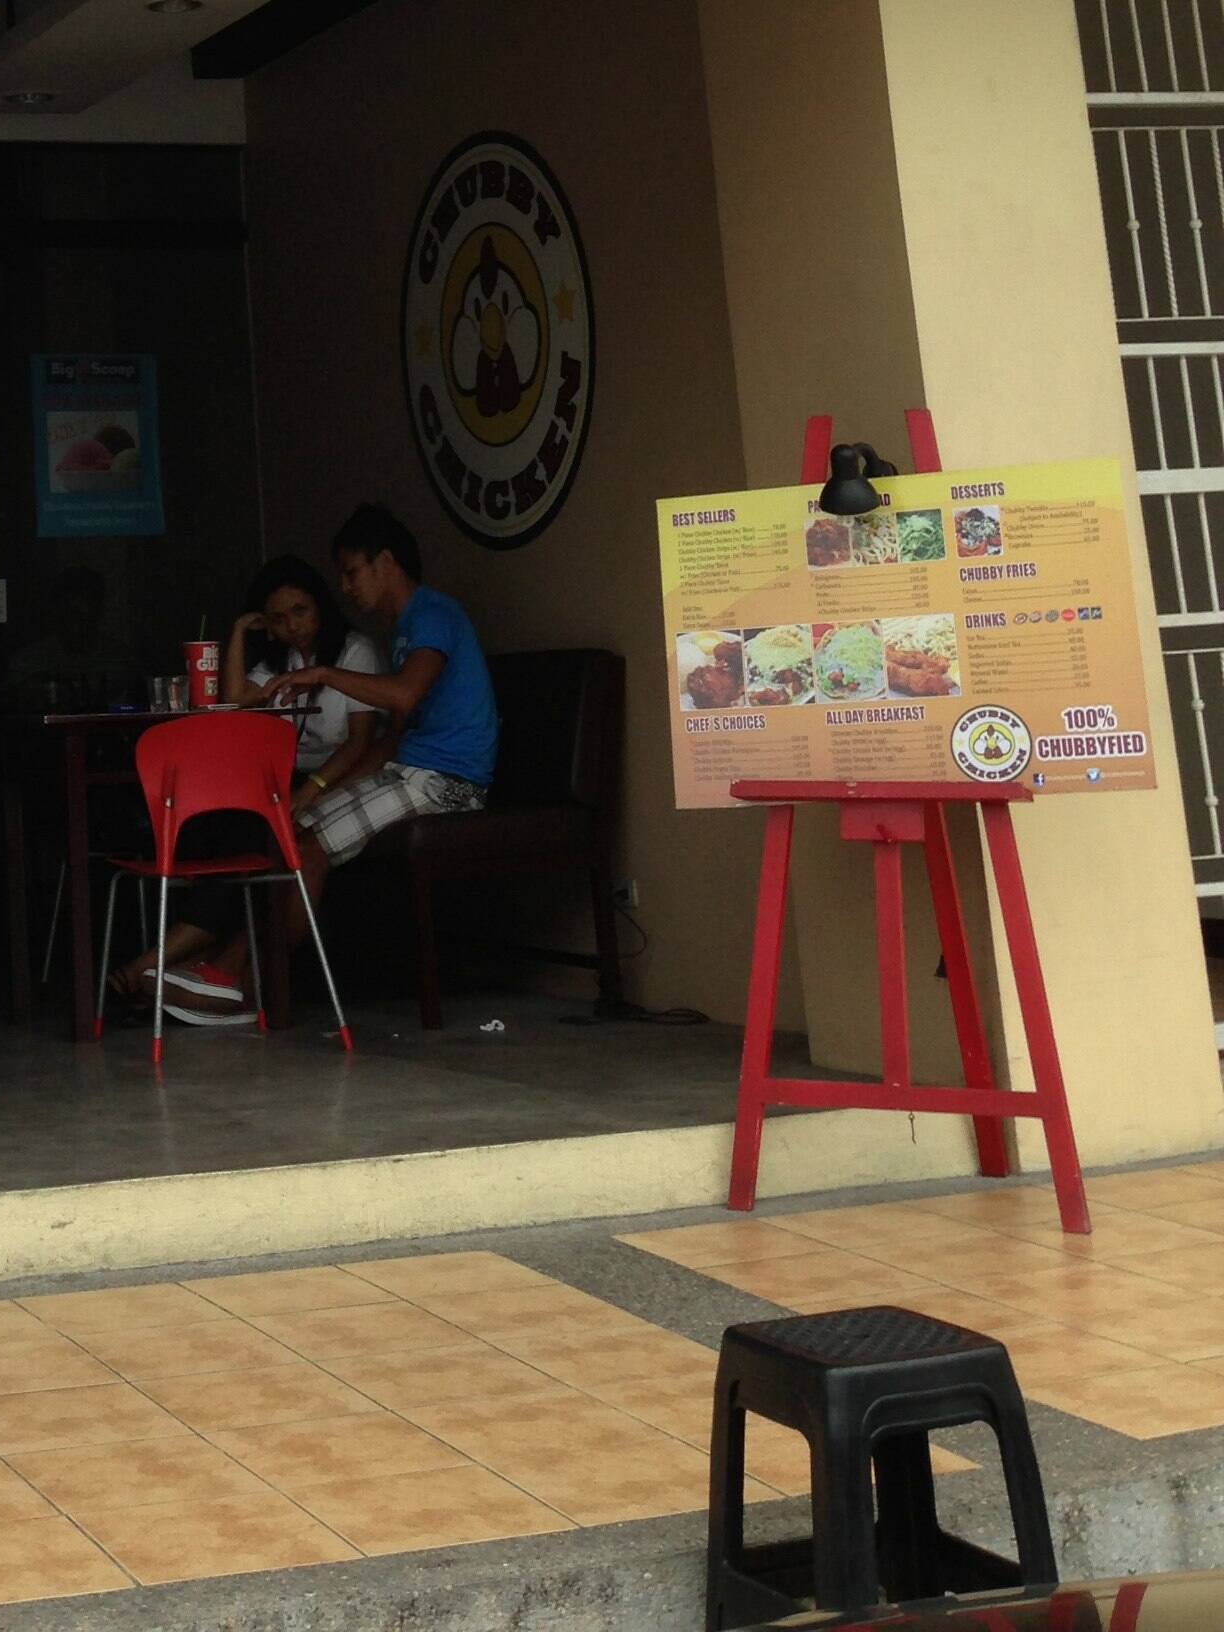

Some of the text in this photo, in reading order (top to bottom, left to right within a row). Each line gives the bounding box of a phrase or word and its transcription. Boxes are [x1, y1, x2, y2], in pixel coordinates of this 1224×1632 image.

[419, 160, 561, 285] CHUBBY
[419, 351, 582, 520] CHICKEN
[951, 482, 1005, 500] DESSERTS
[672, 508, 736, 527] BEST SELLERS
[959, 563, 1037, 582] CHUBBY FRIES
[965, 613, 1007, 629] DRINKS
[722, 714, 766, 729] CHOICES
[826, 706, 925, 725] ALL DAY BREAKFAST
[959, 710, 1021, 732] CHUBBY
[1064, 707, 1115, 729] 100%
[1038, 734, 1144, 759] CHUBBYFIED
[958, 748, 1027, 781] CHICKEN
